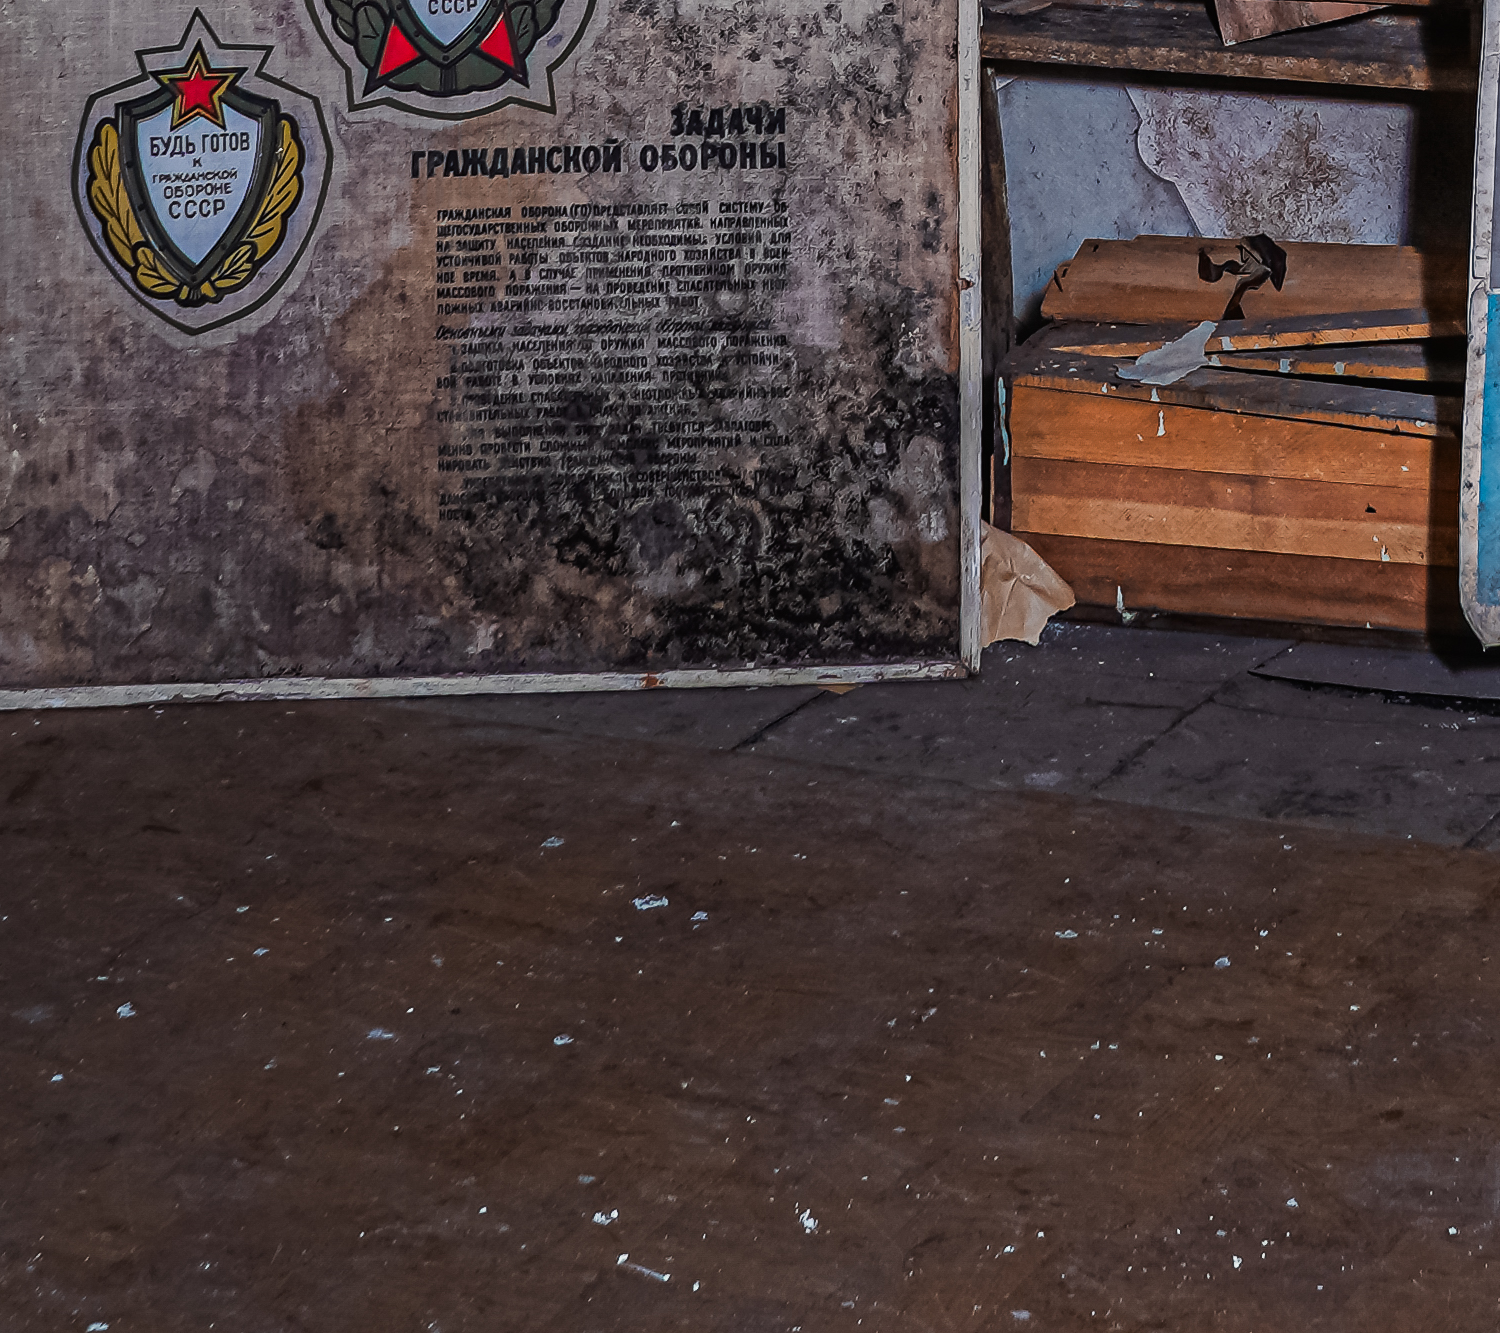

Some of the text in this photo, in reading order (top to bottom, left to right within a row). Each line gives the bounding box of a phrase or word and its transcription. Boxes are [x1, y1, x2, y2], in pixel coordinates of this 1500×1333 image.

[670, 105, 786, 136] ЗАДАЧИ
[150, 132, 249, 157] БУДЬ ГОТОВ
[193, 157, 202, 167] К
[411, 138, 786, 178] ГРАЖДАНСКОЙ ОБОРОНЫ
[152, 168, 237, 183] ГРАЖДАНСКОЙ
[164, 183, 232, 199] ОБОРОНЕ
[169, 199, 225, 219] СССР
